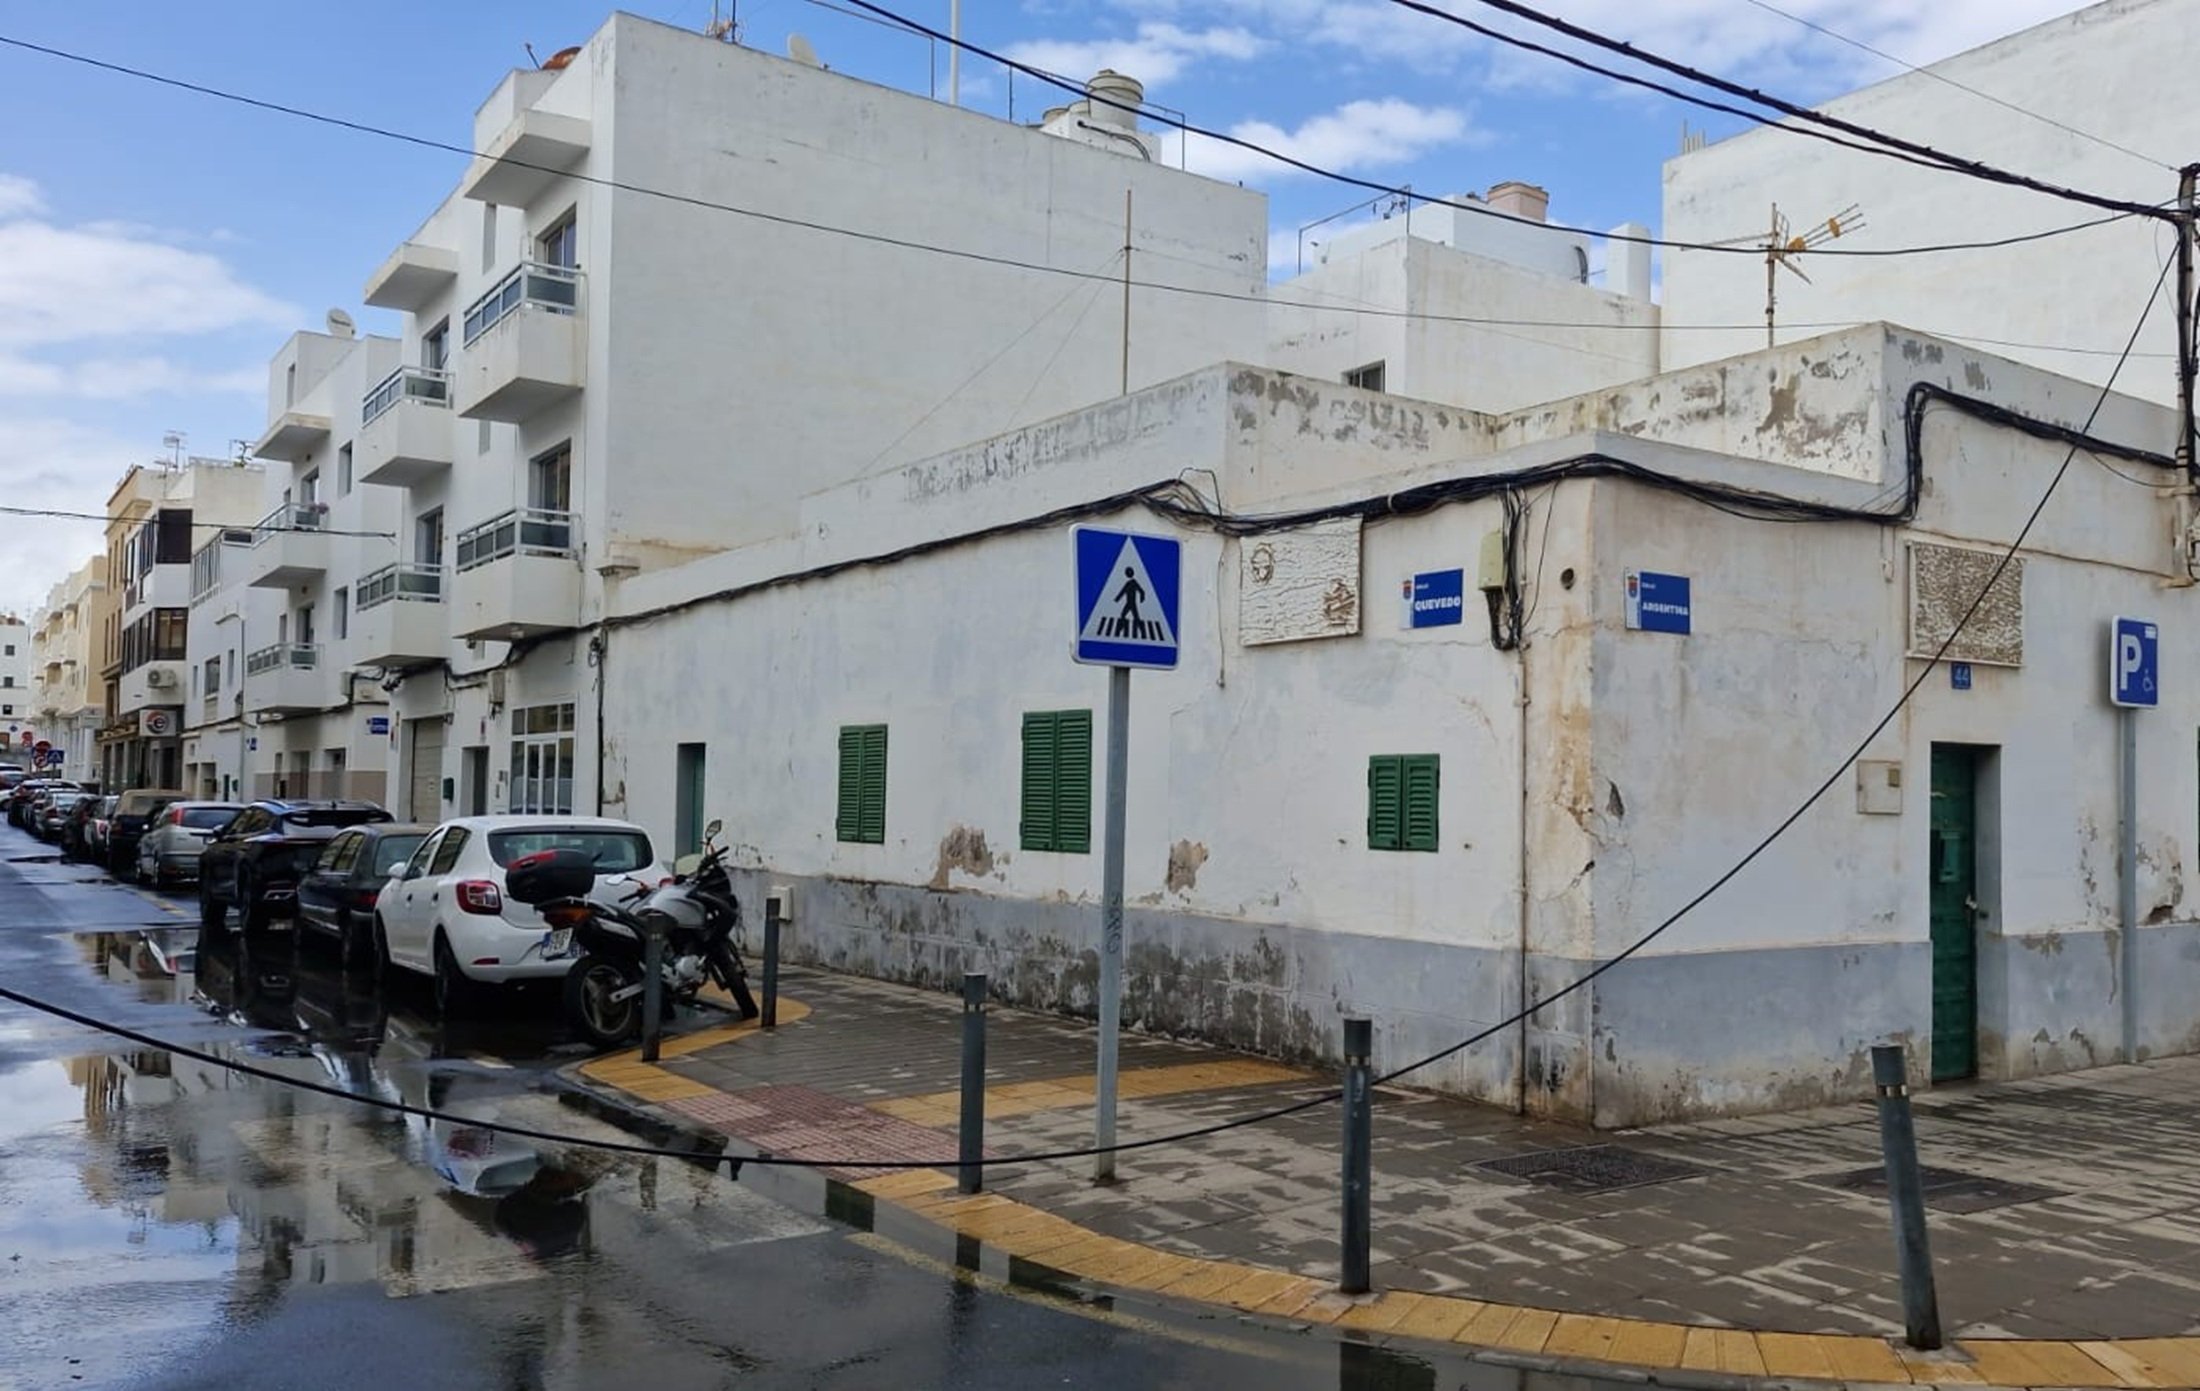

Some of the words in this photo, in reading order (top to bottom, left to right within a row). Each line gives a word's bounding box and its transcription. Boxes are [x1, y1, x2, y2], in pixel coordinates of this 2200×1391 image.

[1415, 596, 1461, 611] QUEVEDO
[1642, 602, 1689, 616] ARGENTINA
[2120, 633, 2142, 691] P
